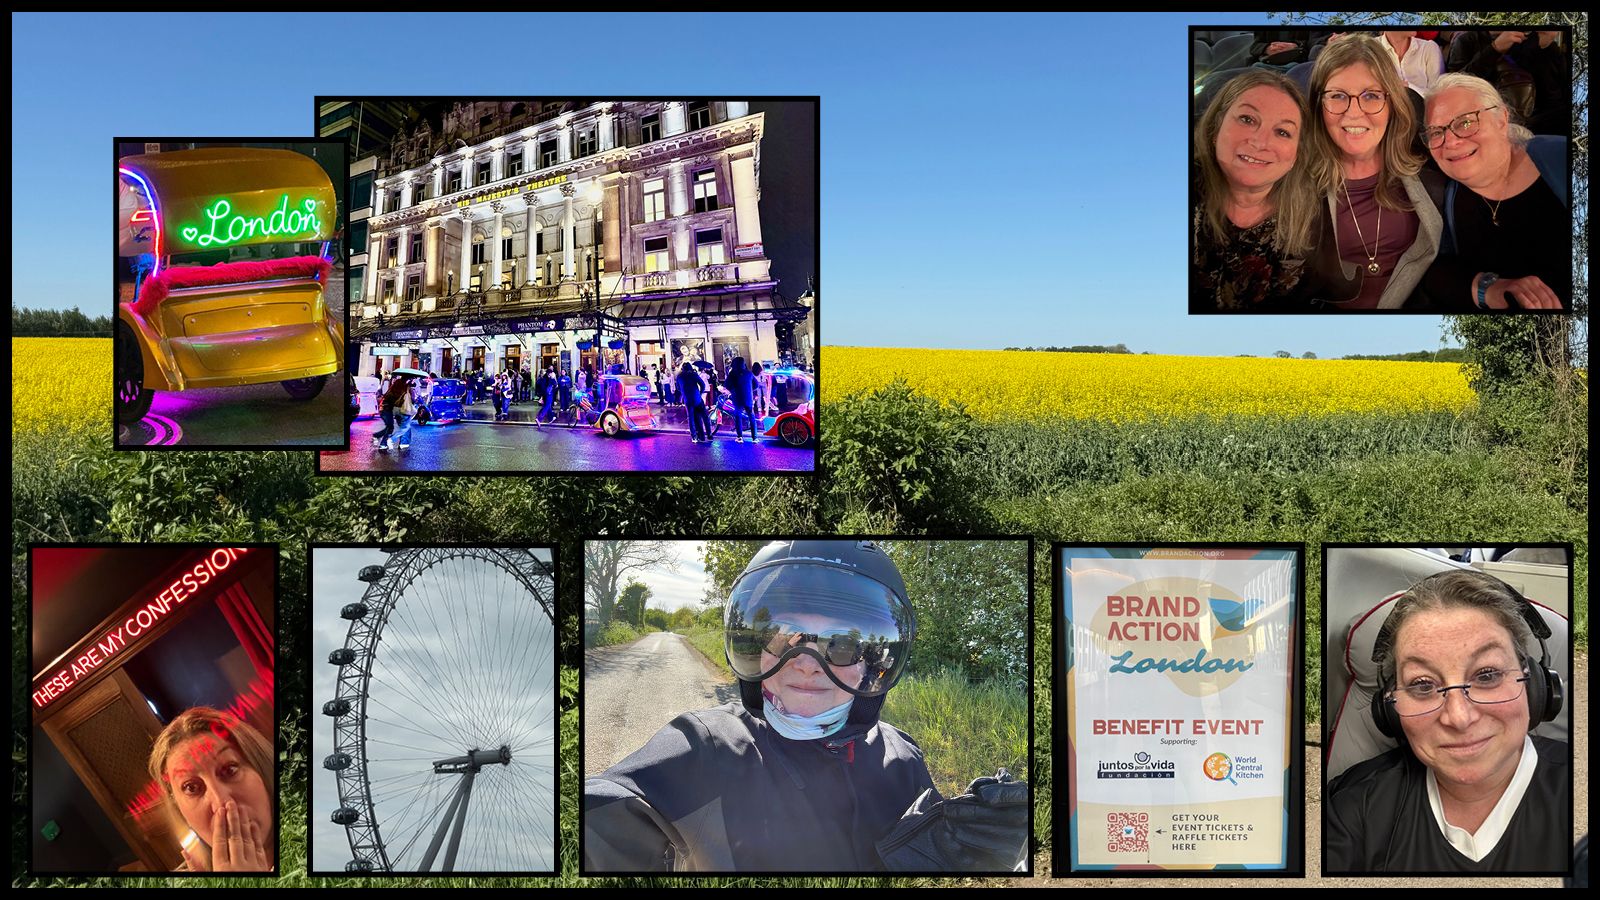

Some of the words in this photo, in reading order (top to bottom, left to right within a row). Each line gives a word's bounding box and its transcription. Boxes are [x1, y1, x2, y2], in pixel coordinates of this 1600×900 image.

[457, 200, 470, 208] HIS
[476, 187, 520, 204] MAJESTY'S
[527, 174, 568, 191] THEATRE
[198, 195, 320, 246] London
[517, 321, 544, 329] PHANTOM
[1107, 596, 1201, 618] BRAND
[1107, 621, 1200, 642] ACTION
[32, 670, 73, 708] THESE
[71, 648, 103, 682] ARE
[98, 628, 126, 658] MY
[1109, 648, 1254, 675] London
[1092, 719, 1185, 735] BENEFIT
[1192, 719, 1265, 735] EVENT
[1160, 737, 1198, 746] Supporting:
[1098, 760, 1134, 772] juntos
[1151, 760, 1175, 770] vida
[1172, 814, 1190, 822] GET
[1192, 814, 1220, 822] YOUR
[1172, 843, 1197, 851] HERE
